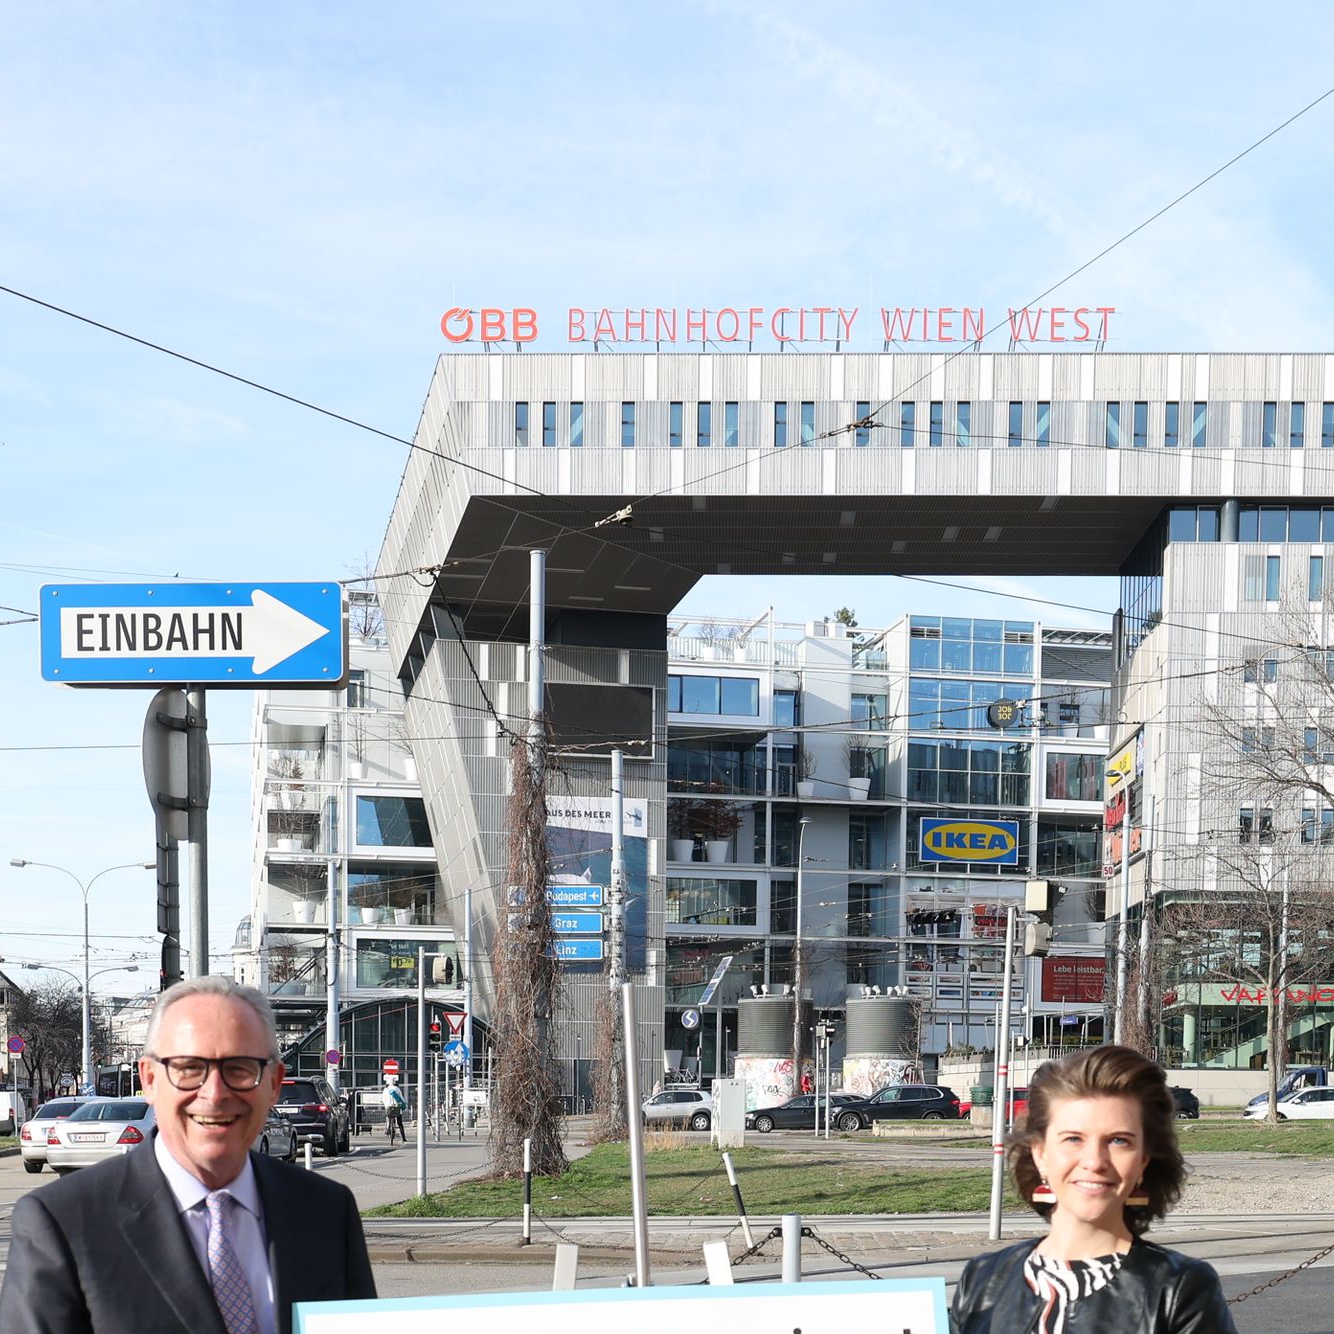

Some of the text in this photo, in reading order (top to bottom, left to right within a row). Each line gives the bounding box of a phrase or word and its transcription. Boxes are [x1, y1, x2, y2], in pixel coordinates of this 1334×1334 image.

[441, 307, 1115, 343] ÖBB BAHNHOFCITY WIEN WEST
[77, 613, 242, 651] EINBAHN
[565, 810, 582, 818] DES
[932, 831, 1009, 850] IKEA
[1103, 866, 1113, 875] 50
[547, 891, 586, 903] Budapest
[555, 918, 578, 929] Graz
[556, 945, 578, 955] Linz
[1053, 965, 1105, 974] Lebe leistbar.
